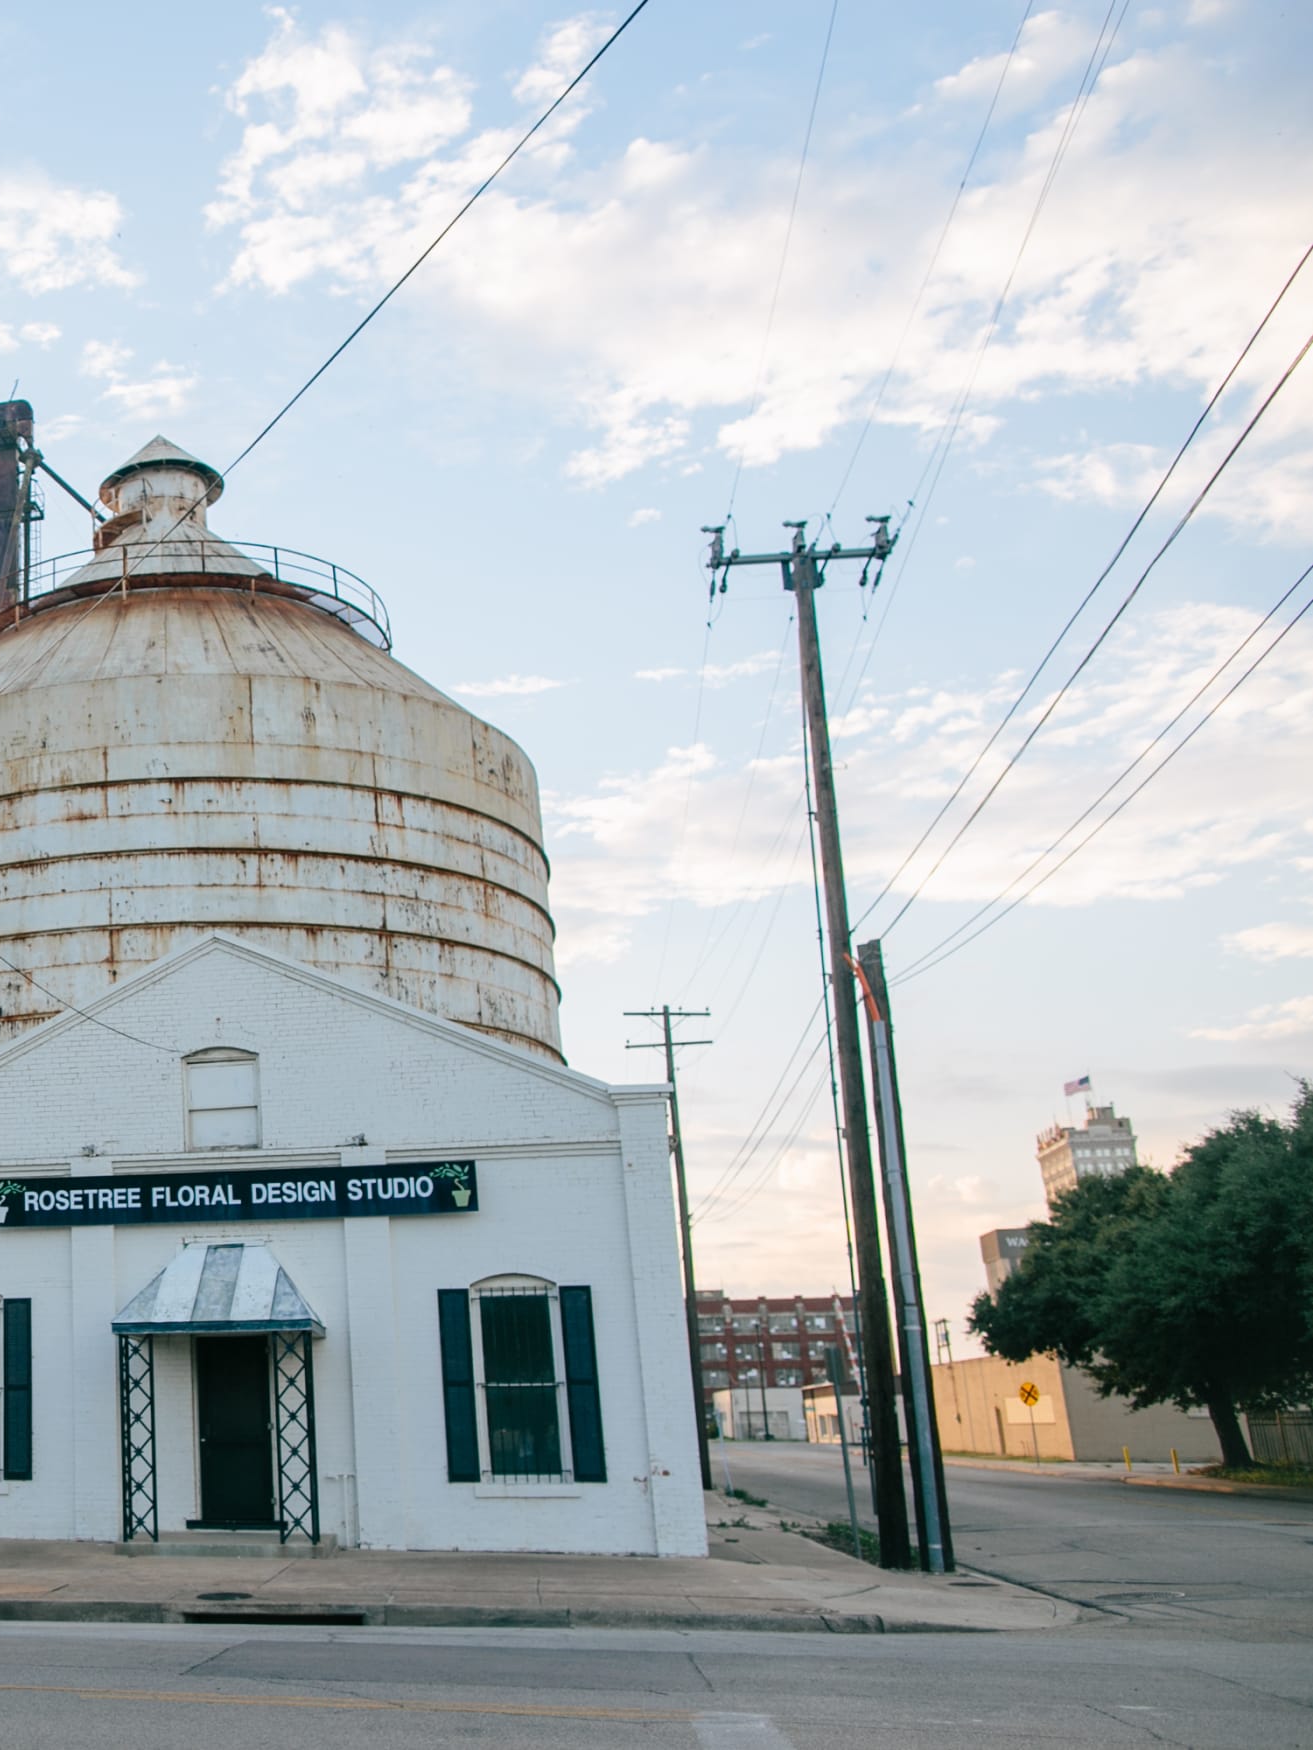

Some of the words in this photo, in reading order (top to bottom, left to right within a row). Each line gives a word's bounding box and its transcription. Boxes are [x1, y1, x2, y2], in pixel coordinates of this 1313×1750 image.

[24, 1187, 142, 1212] ROSETREE
[152, 1184, 242, 1207] FLORAL
[251, 1180, 336, 1204] DESIGN
[347, 1175, 434, 1200] STUDIO
